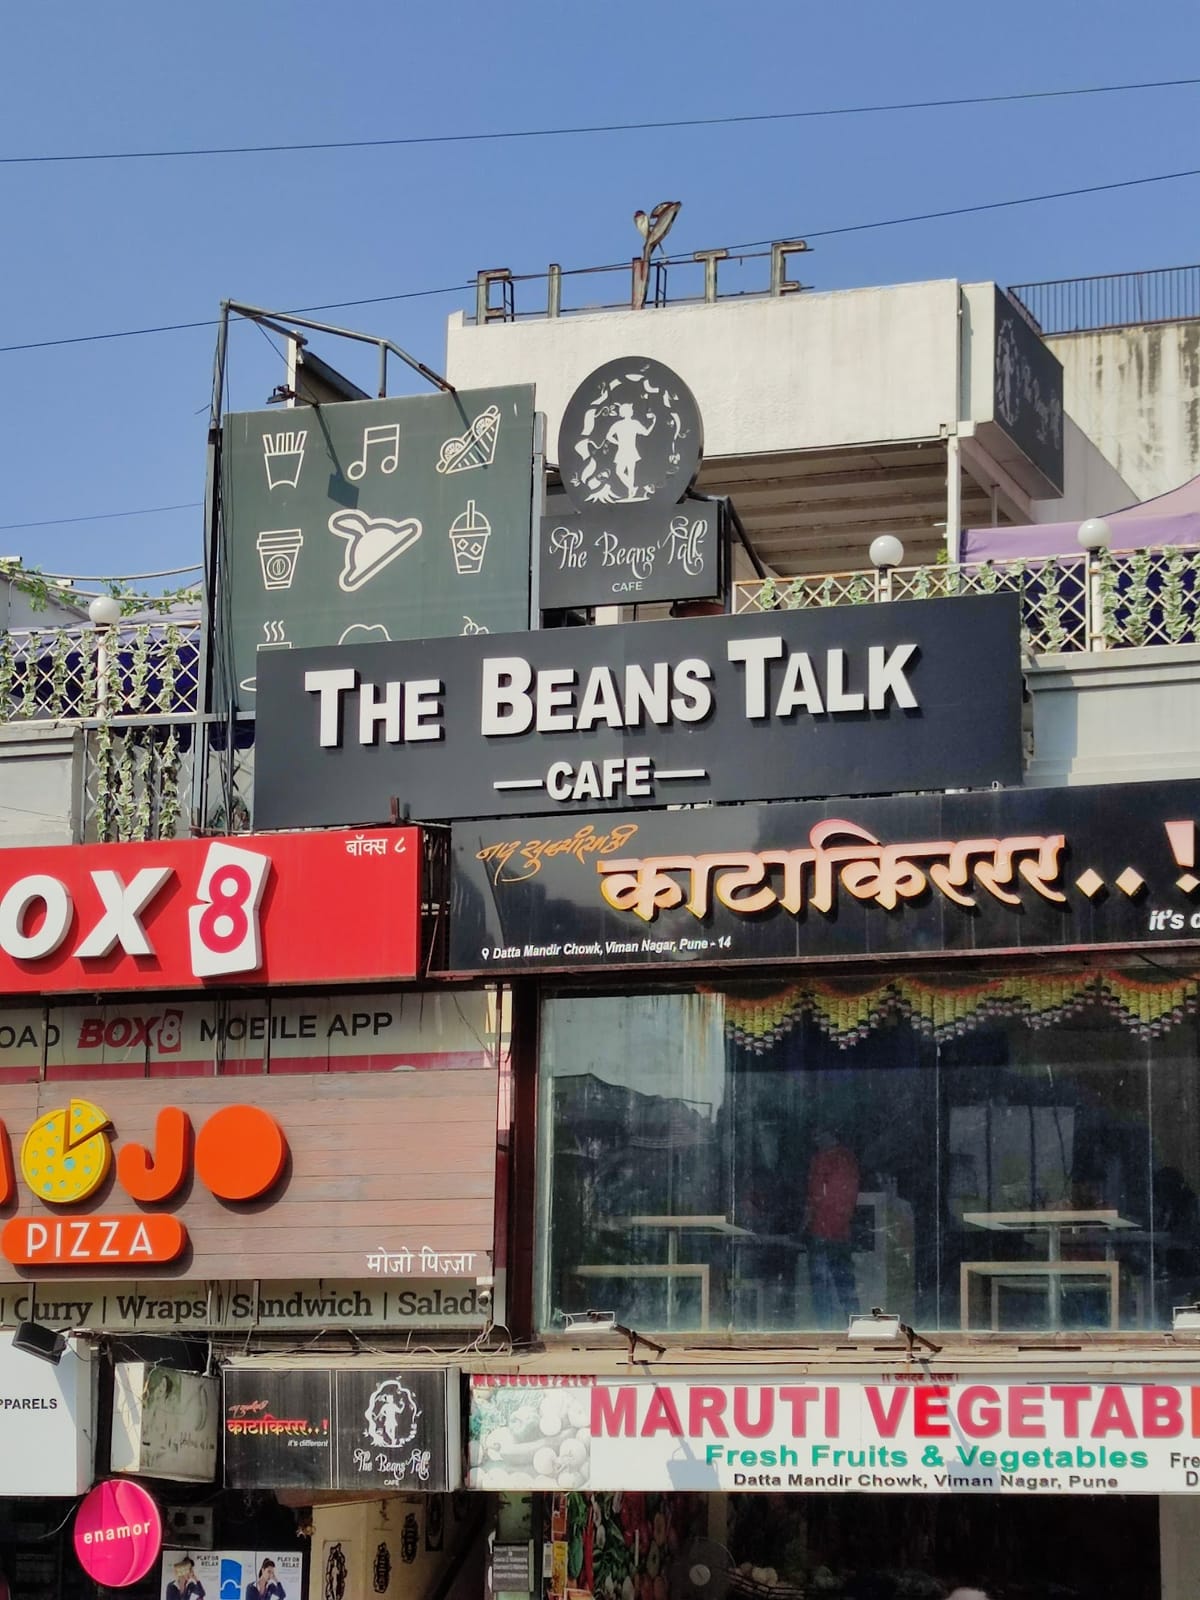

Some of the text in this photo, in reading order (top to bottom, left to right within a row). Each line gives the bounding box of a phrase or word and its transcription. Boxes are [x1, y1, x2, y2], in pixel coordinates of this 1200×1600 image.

[549, 527, 588, 570] The
[611, 581, 643, 593] CAFE
[546, 757, 653, 801] CAFE
[345, 834, 407, 856] बॉक्स ८
[1149, 909, 1185, 931] it's
[493, 947, 521, 960] Datta
[523, 943, 562, 957] Mandir
[563, 942, 604, 955] Chowk,
[605, 939, 640, 954] Viman
[641, 938, 677, 953] Nagar,
[679, 937, 708, 951] Pune
[718, 936, 731, 949] 14
[200, 1015, 317, 1042] MOBILE
[326, 1012, 393, 1037] APP
[26, 1221, 153, 1258] PIZZA
[366, 1246, 415, 1274] मोजो
[14, 1297, 93, 1326] Curry
[116, 1295, 207, 1324] Wraps
[231, 1291, 373, 1318] Sandwich
[590, 1386, 840, 1438] MARUTI
[706, 1444, 1148, 1473] Fresh Fruits & Vegetables
[734, 1474, 1118, 1490] Datta Mandir Chowk, Viman Nagar, Pune
[83, 1521, 151, 1544] enamor
